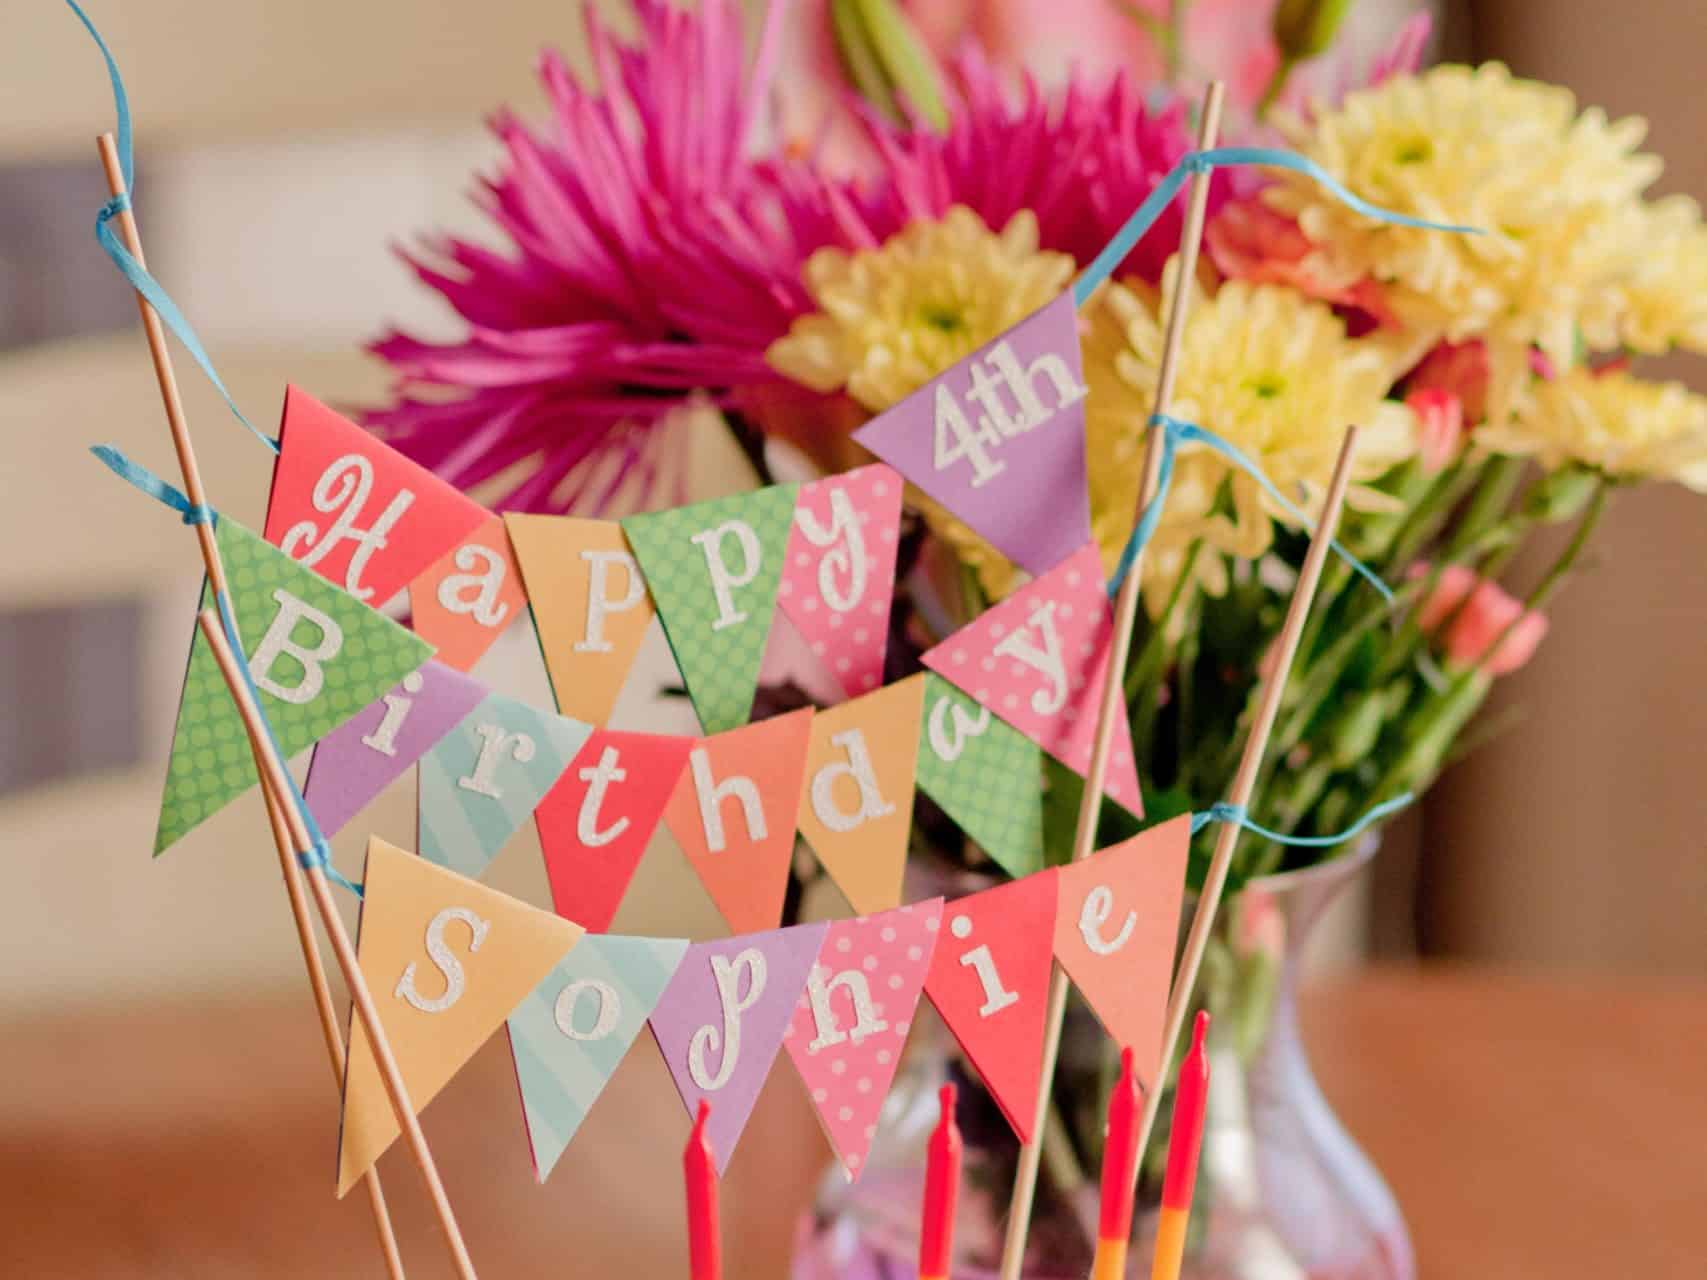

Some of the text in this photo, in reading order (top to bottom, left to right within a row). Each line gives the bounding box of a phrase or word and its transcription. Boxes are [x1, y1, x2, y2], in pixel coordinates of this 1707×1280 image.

[279, 339, 1090, 652] Happy 4th
[248, 587, 1069, 853] Birthday
[394, 884, 1138, 1090] Sophie
